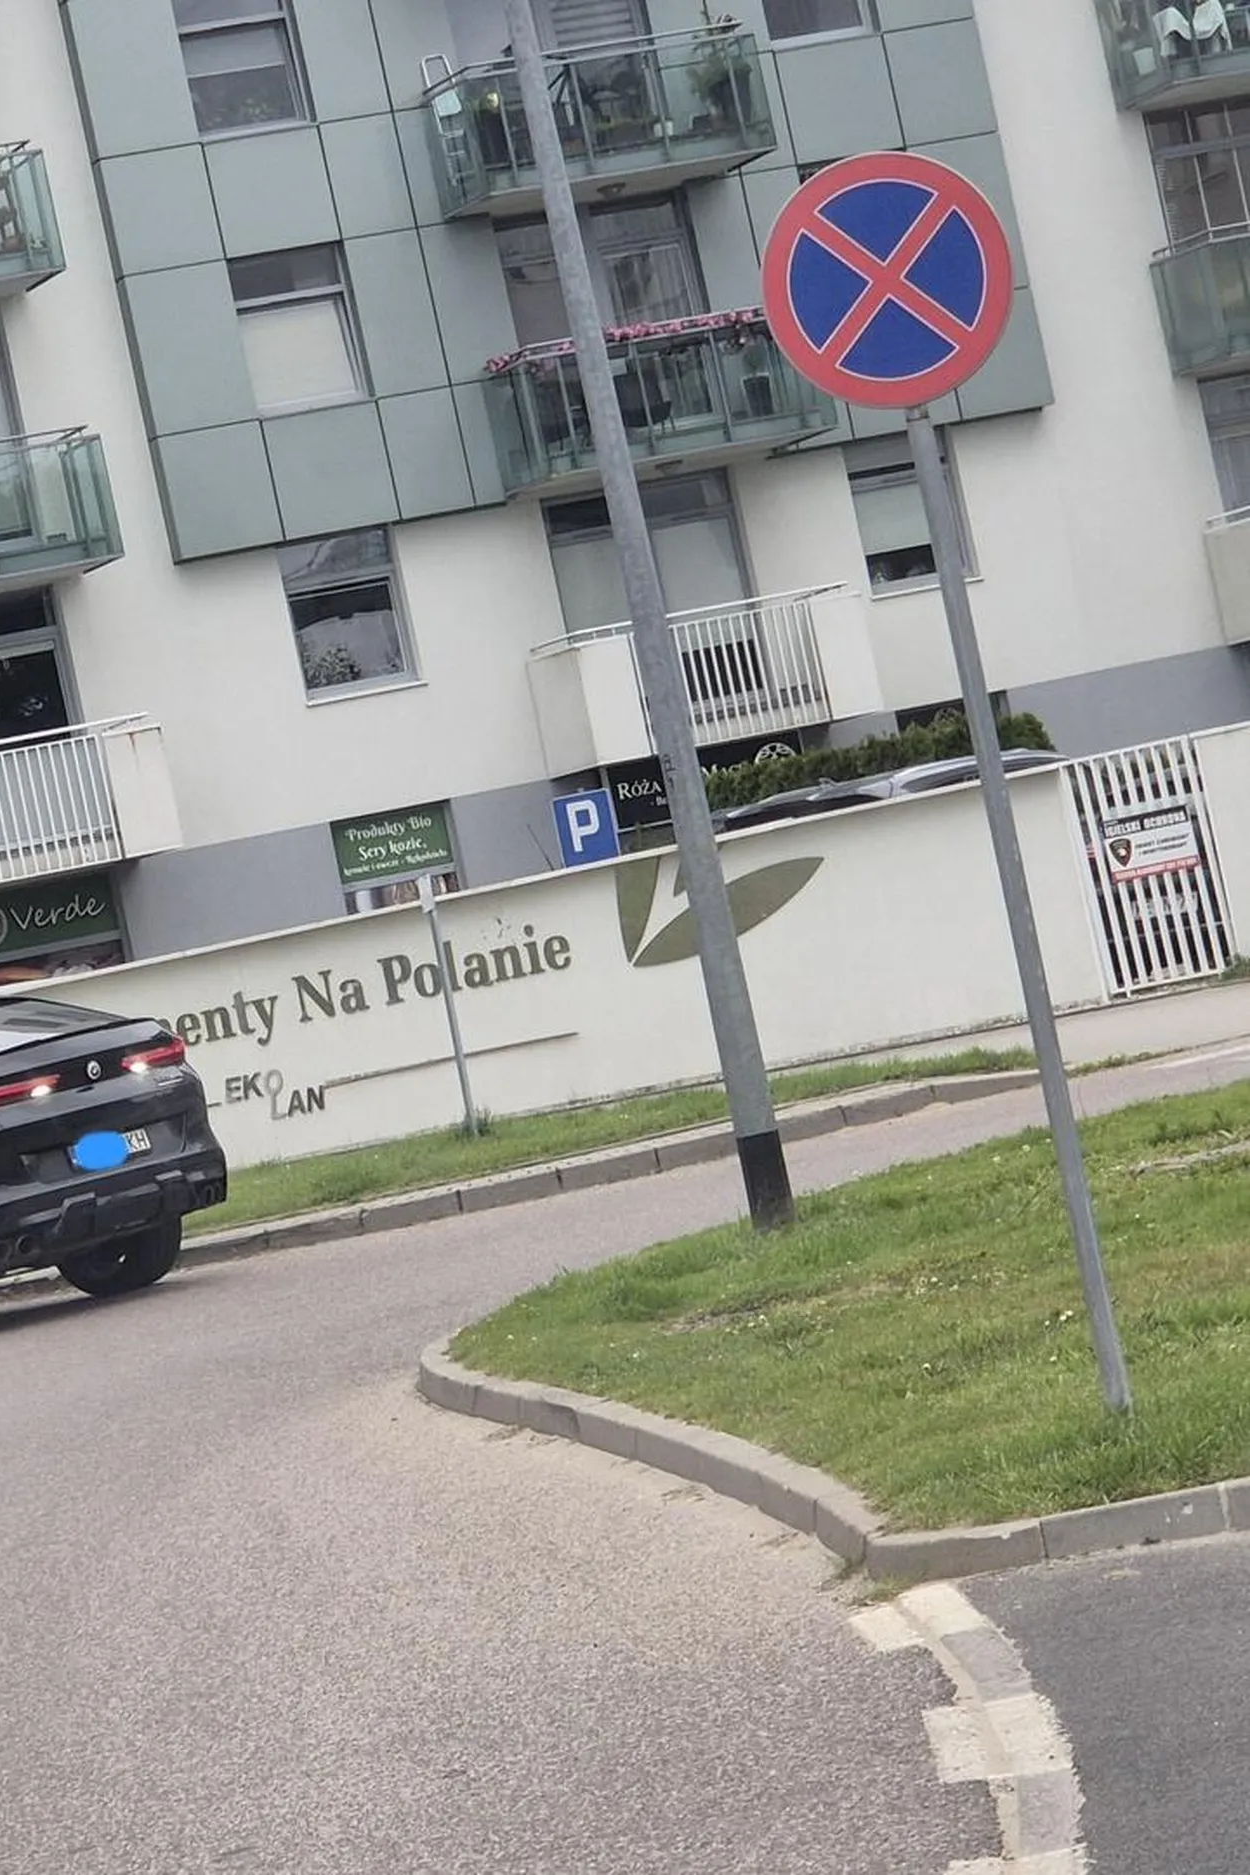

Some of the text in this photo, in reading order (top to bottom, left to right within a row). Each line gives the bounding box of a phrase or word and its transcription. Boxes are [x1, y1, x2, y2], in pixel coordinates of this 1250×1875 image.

[617, 779, 663, 801] RÓŻA
[345, 816, 432, 842] Produkty Bio
[565, 799, 600, 853] P
[358, 844, 387, 861] Sery
[10, 893, 106, 930] Verde
[291, 969, 370, 1024] Na
[376, 923, 572, 1007] Polanie
